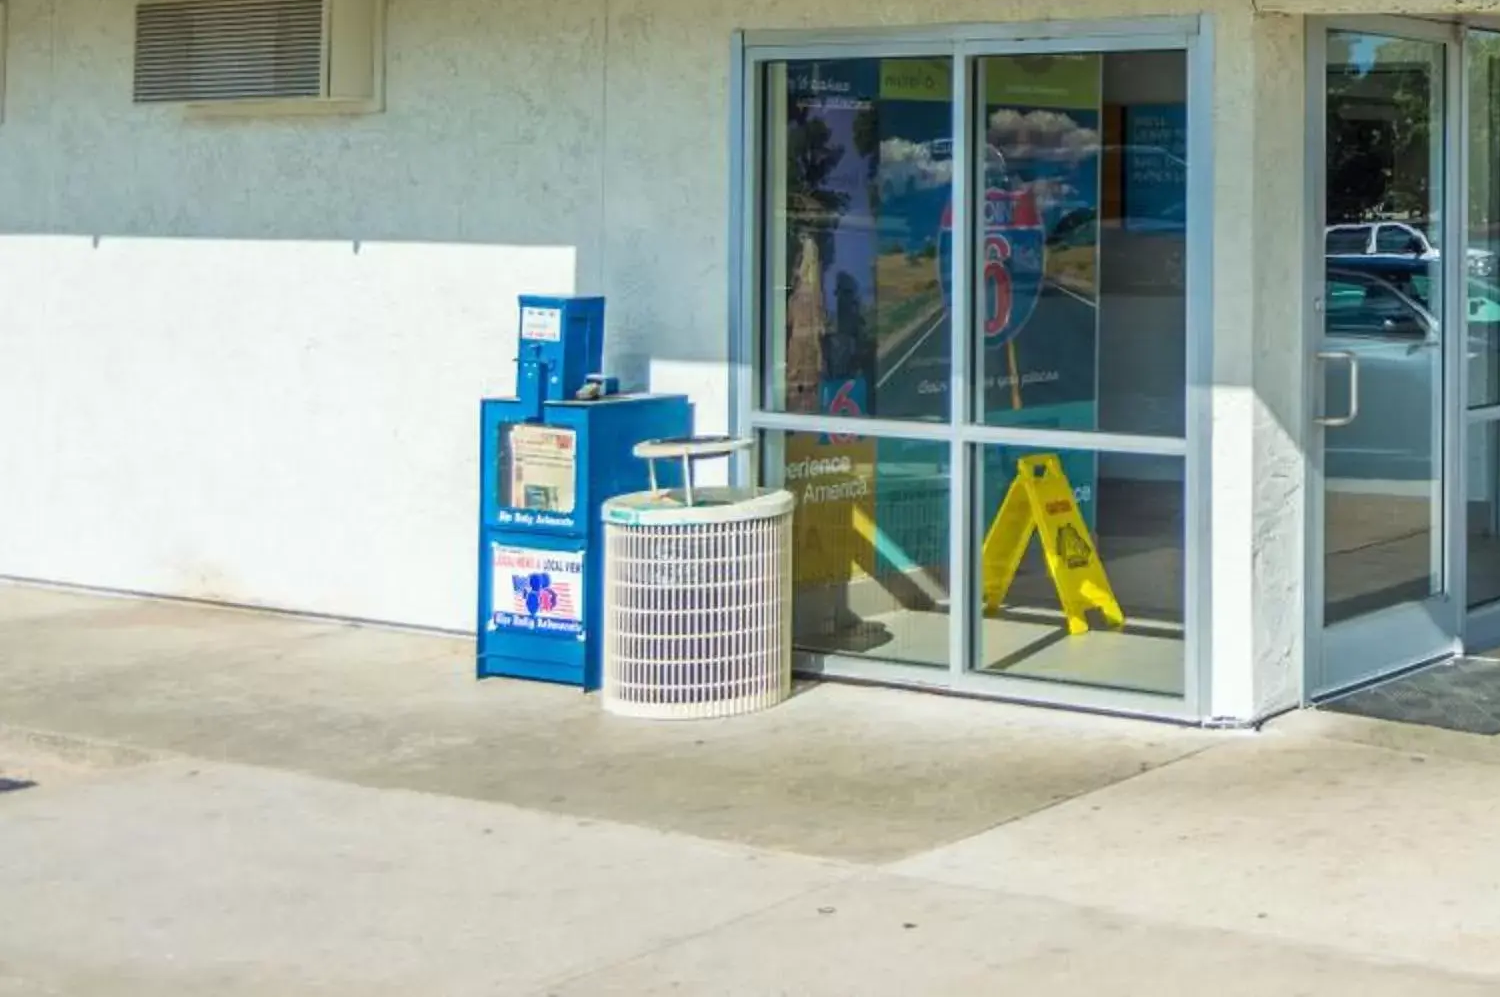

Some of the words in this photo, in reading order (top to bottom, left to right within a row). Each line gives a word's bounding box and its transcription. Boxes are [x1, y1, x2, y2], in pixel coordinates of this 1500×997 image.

[829, 379, 862, 445] 6
[785, 454, 852, 480] erience
[803, 478, 867, 504] America
